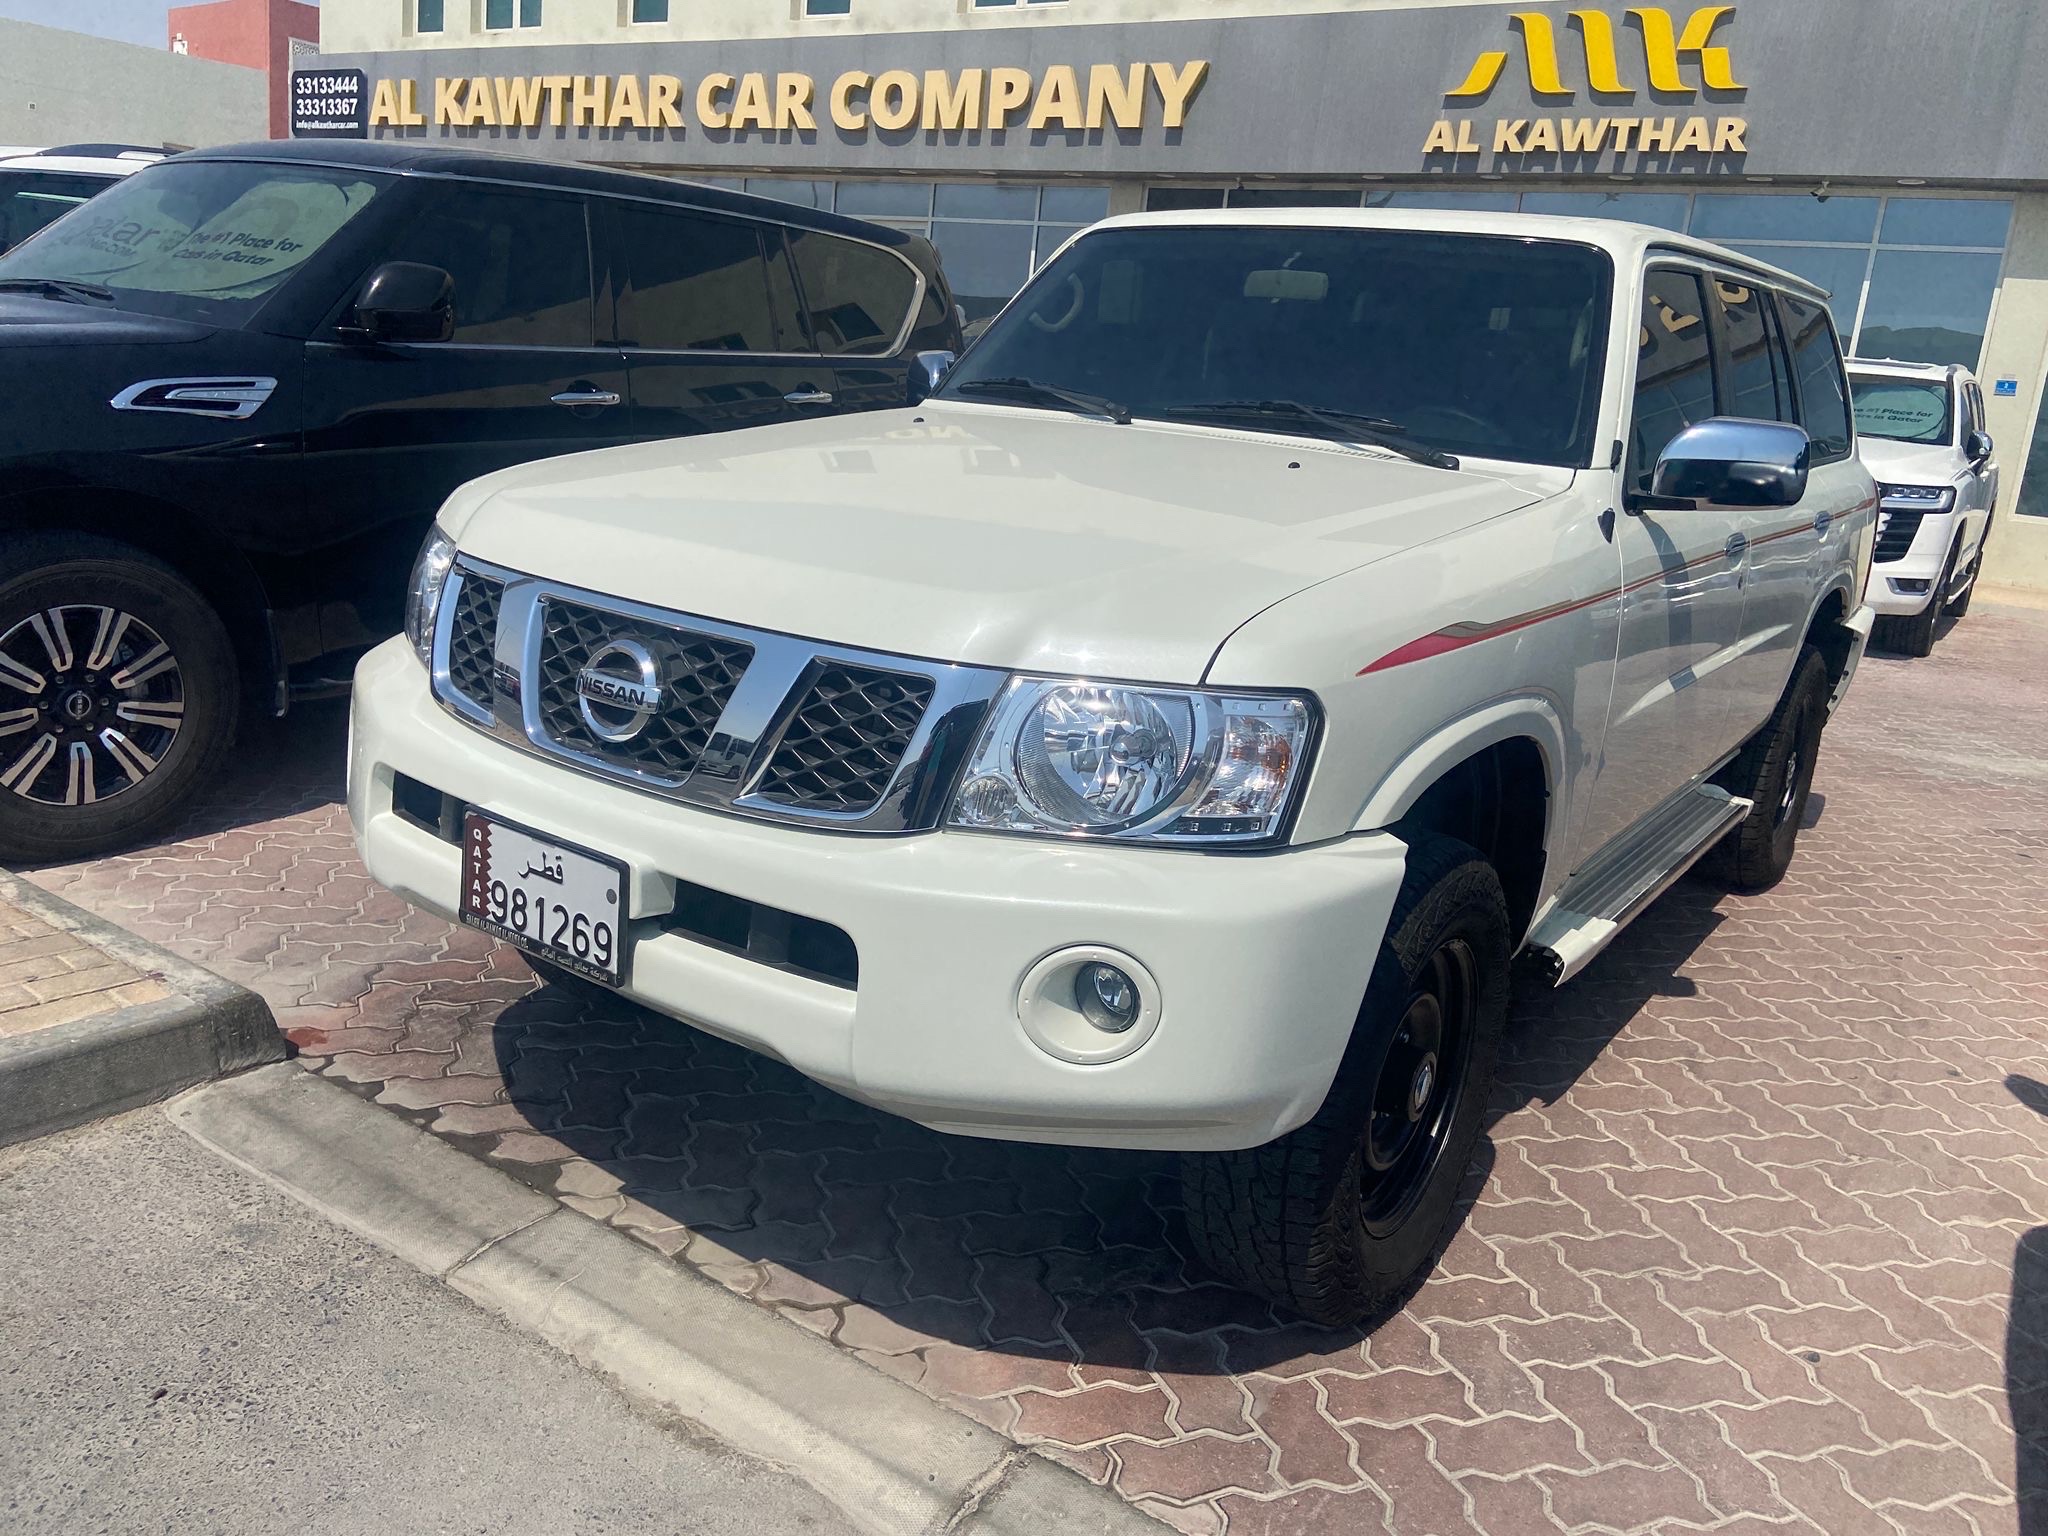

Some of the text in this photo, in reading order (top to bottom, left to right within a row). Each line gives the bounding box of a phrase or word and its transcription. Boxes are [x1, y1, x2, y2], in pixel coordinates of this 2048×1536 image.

[296, 76, 359, 94] 33133444
[369, 60, 1210, 130] AL KAWTHAR CAR COMPANY
[296, 98, 358, 115] 33313367
[1422, 117, 1748, 154] AL KAWTHAR
[228, 232, 274, 250] Place
[273, 238, 304, 253] for
[222, 251, 275, 266] Qatar
[1881, 408, 1913, 416] Place
[1916, 410, 1934, 418] for
[1887, 414, 1924, 423] Qatar
[580, 672, 645, 706] NISSAN
[472, 828, 482, 909] QATAR
[518, 851, 564, 885] قطر
[491, 880, 613, 968] 981269
